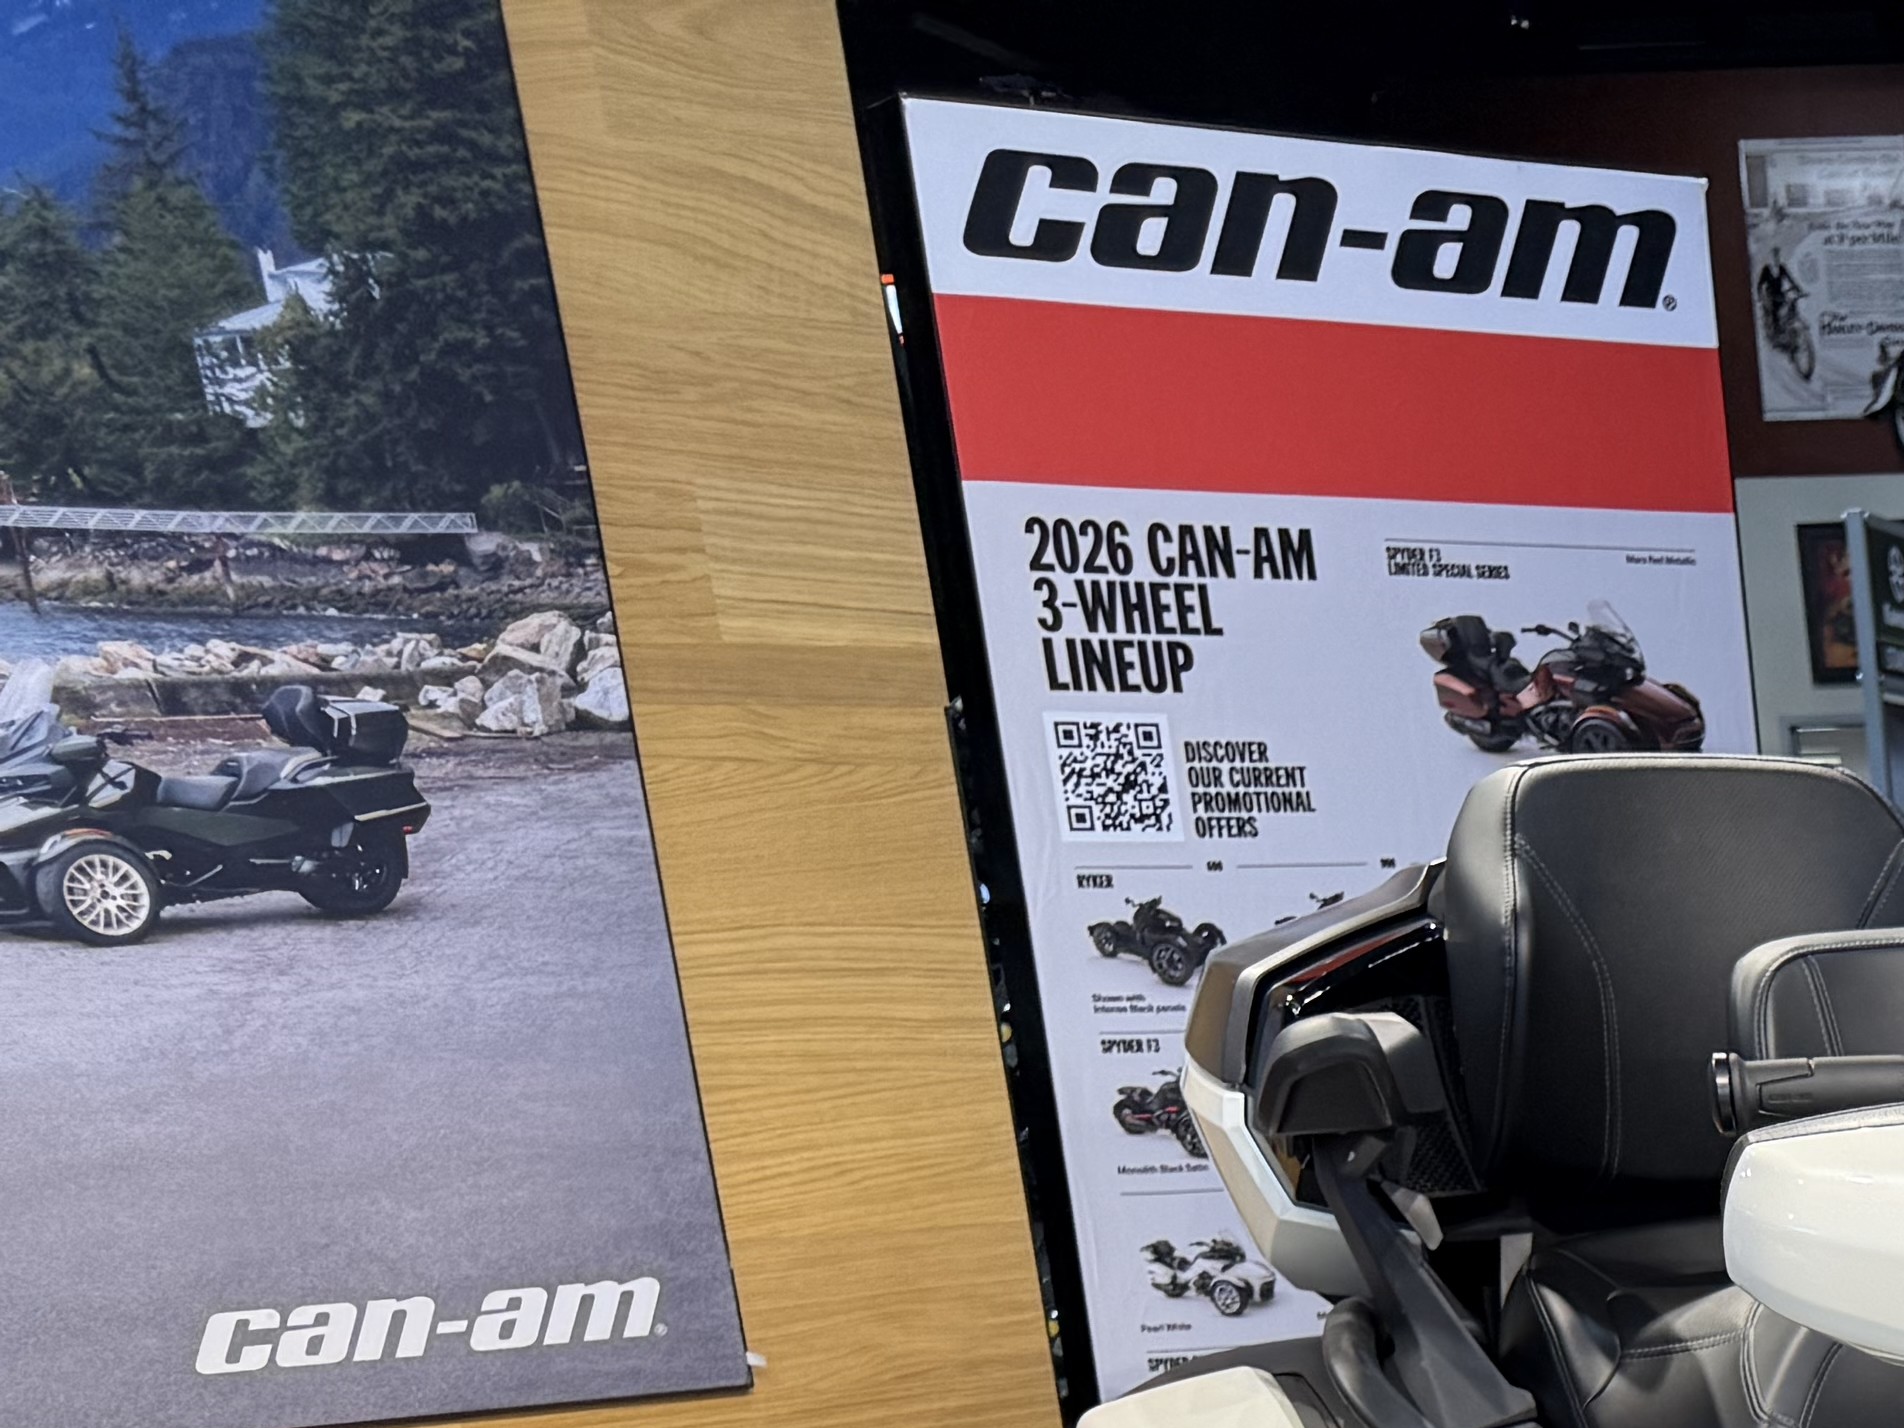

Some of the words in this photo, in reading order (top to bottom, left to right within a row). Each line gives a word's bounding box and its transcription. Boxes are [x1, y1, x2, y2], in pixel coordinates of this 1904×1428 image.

[962, 148, 1678, 308] can-am
[1024, 516, 1134, 576] 2026
[1147, 521, 1318, 581] CAN-AM
[1033, 577, 1225, 636] 3-WHEEL
[1041, 637, 1195, 694] LINEUP
[1183, 741, 1269, 764] DISCOVER
[1188, 766, 1223, 788] OUR
[1229, 766, 1306, 788] CURRENT
[1191, 791, 1317, 814] PROMOTIONAL
[1195, 816, 1259, 839] OFFERS
[1077, 874, 1114, 889] RYKER
[1101, 1039, 1143, 1054] SPYDER
[195, 1277, 661, 1376] can-am
